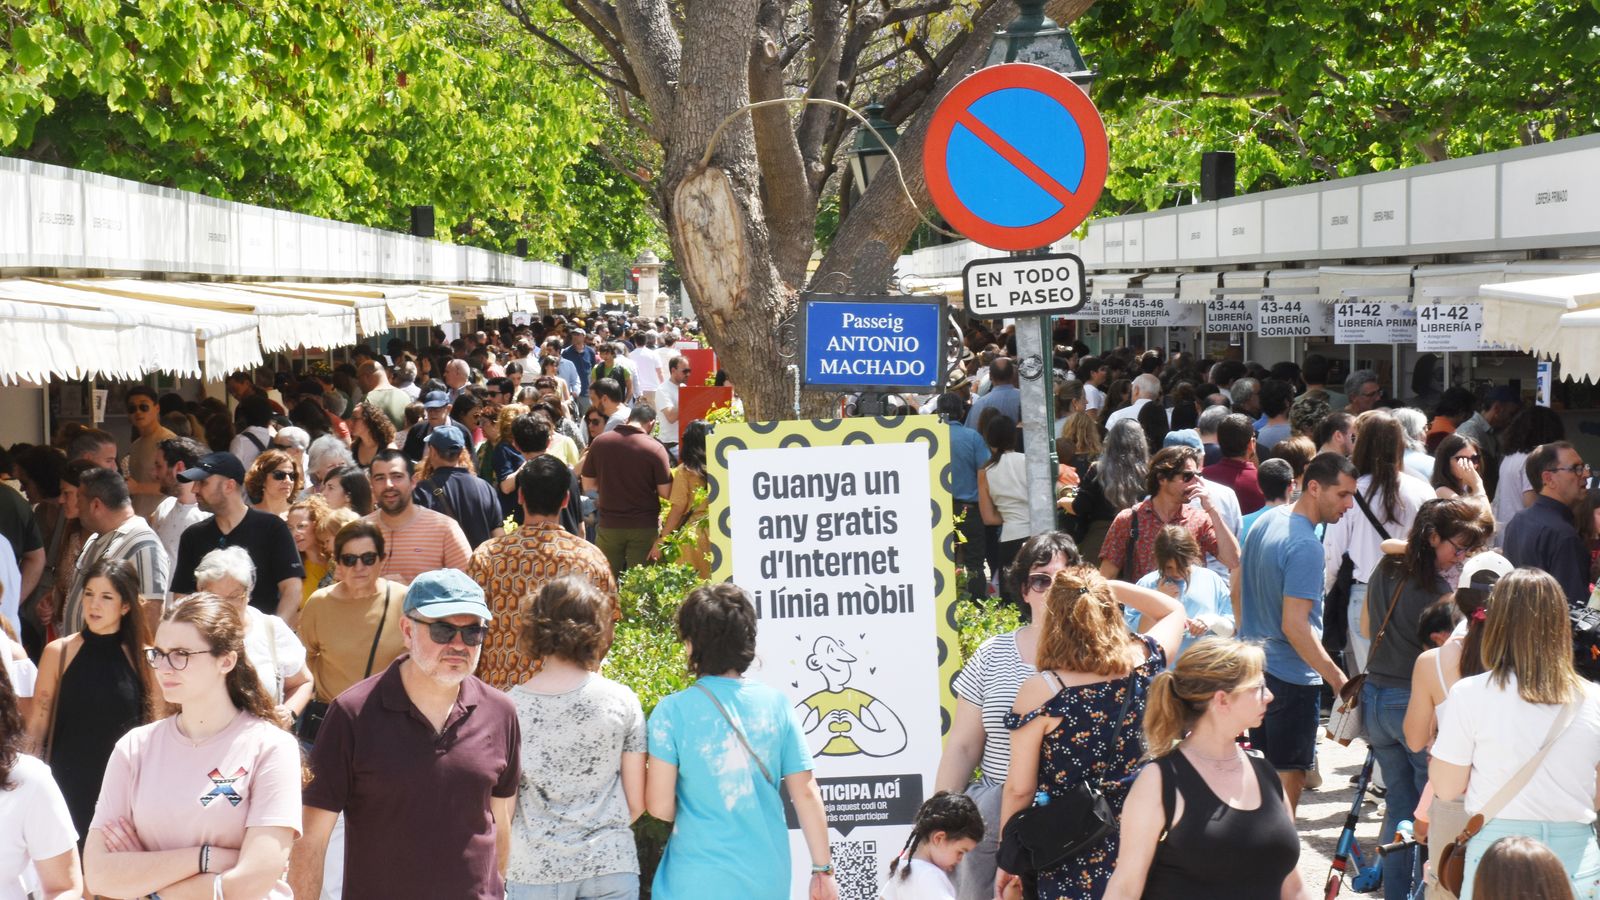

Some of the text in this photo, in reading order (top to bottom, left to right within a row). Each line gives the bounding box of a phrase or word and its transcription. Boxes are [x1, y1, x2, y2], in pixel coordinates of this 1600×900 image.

[976, 266, 1070, 288] EN TODO
[976, 287, 1074, 308] EL PASEO
[1101, 298, 1130, 307] 45-46
[1132, 299, 1164, 308] 45-46
[1208, 300, 1245, 311] 43-44
[1261, 301, 1301, 313] 43-44
[1338, 304, 1381, 316] 41-42
[1132, 308, 1170, 317] LIBRERÍA
[1208, 312, 1252, 322] LIBRERÍA
[1421, 306, 1468, 320] 41-42
[842, 312, 904, 332] Passeig
[1132, 318, 1158, 326] SEGUÍ
[1261, 313, 1310, 325] LIBRERÍA
[1338, 317, 1417, 327] LIBRERÍA PRIMA
[1208, 323, 1254, 332] SORIANO
[1261, 326, 1311, 336] SORIANO
[1420, 321, 1471, 332] LIBRERÍA
[826, 336, 919, 352] ANTONIO
[820, 358, 925, 375] MACHADO
[752, 470, 900, 502] Guanya un
[758, 506, 898, 543] any gratis
[760, 546, 900, 579] d'Internet
[755, 583, 914, 619] i línia mòbil
[820, 778, 900, 801] TICIPA ACÍ
[837, 802, 860, 812] aquest
[861, 801, 876, 810] codi
[877, 801, 887, 810] QR
[856, 812, 889, 821] participar
